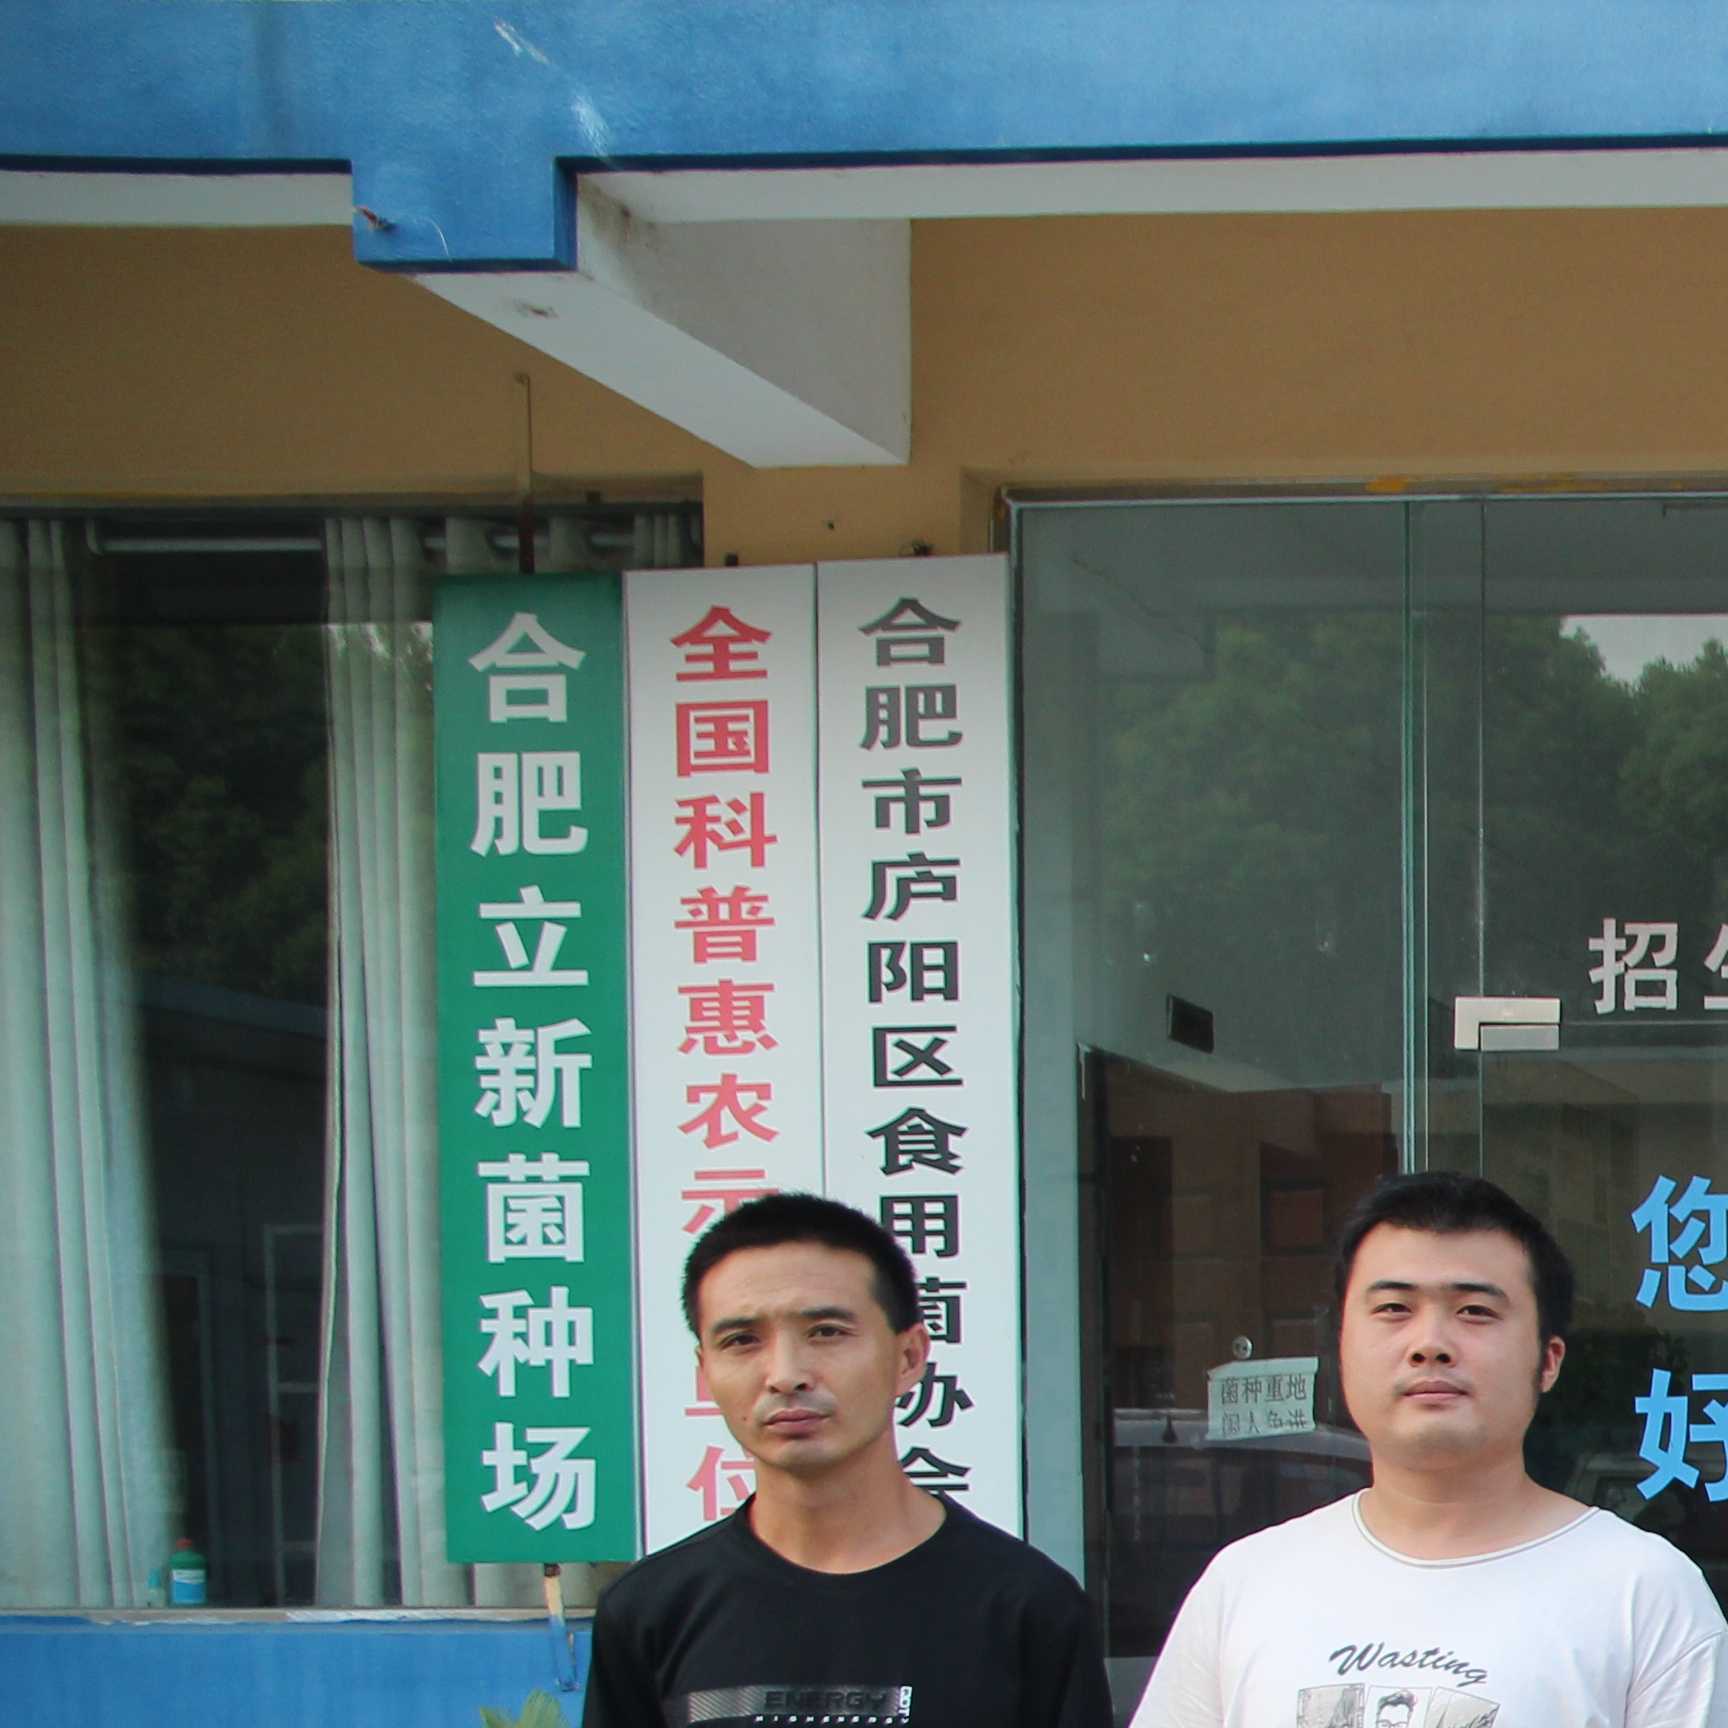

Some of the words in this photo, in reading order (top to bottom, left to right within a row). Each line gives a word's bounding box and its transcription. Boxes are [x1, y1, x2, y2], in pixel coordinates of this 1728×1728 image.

[467, 612, 598, 1531] 合肥立新菌种场
[671, 605, 779, 1521] 全国科普惠农示位
[1328, 1641, 1489, 1688] Wasting
